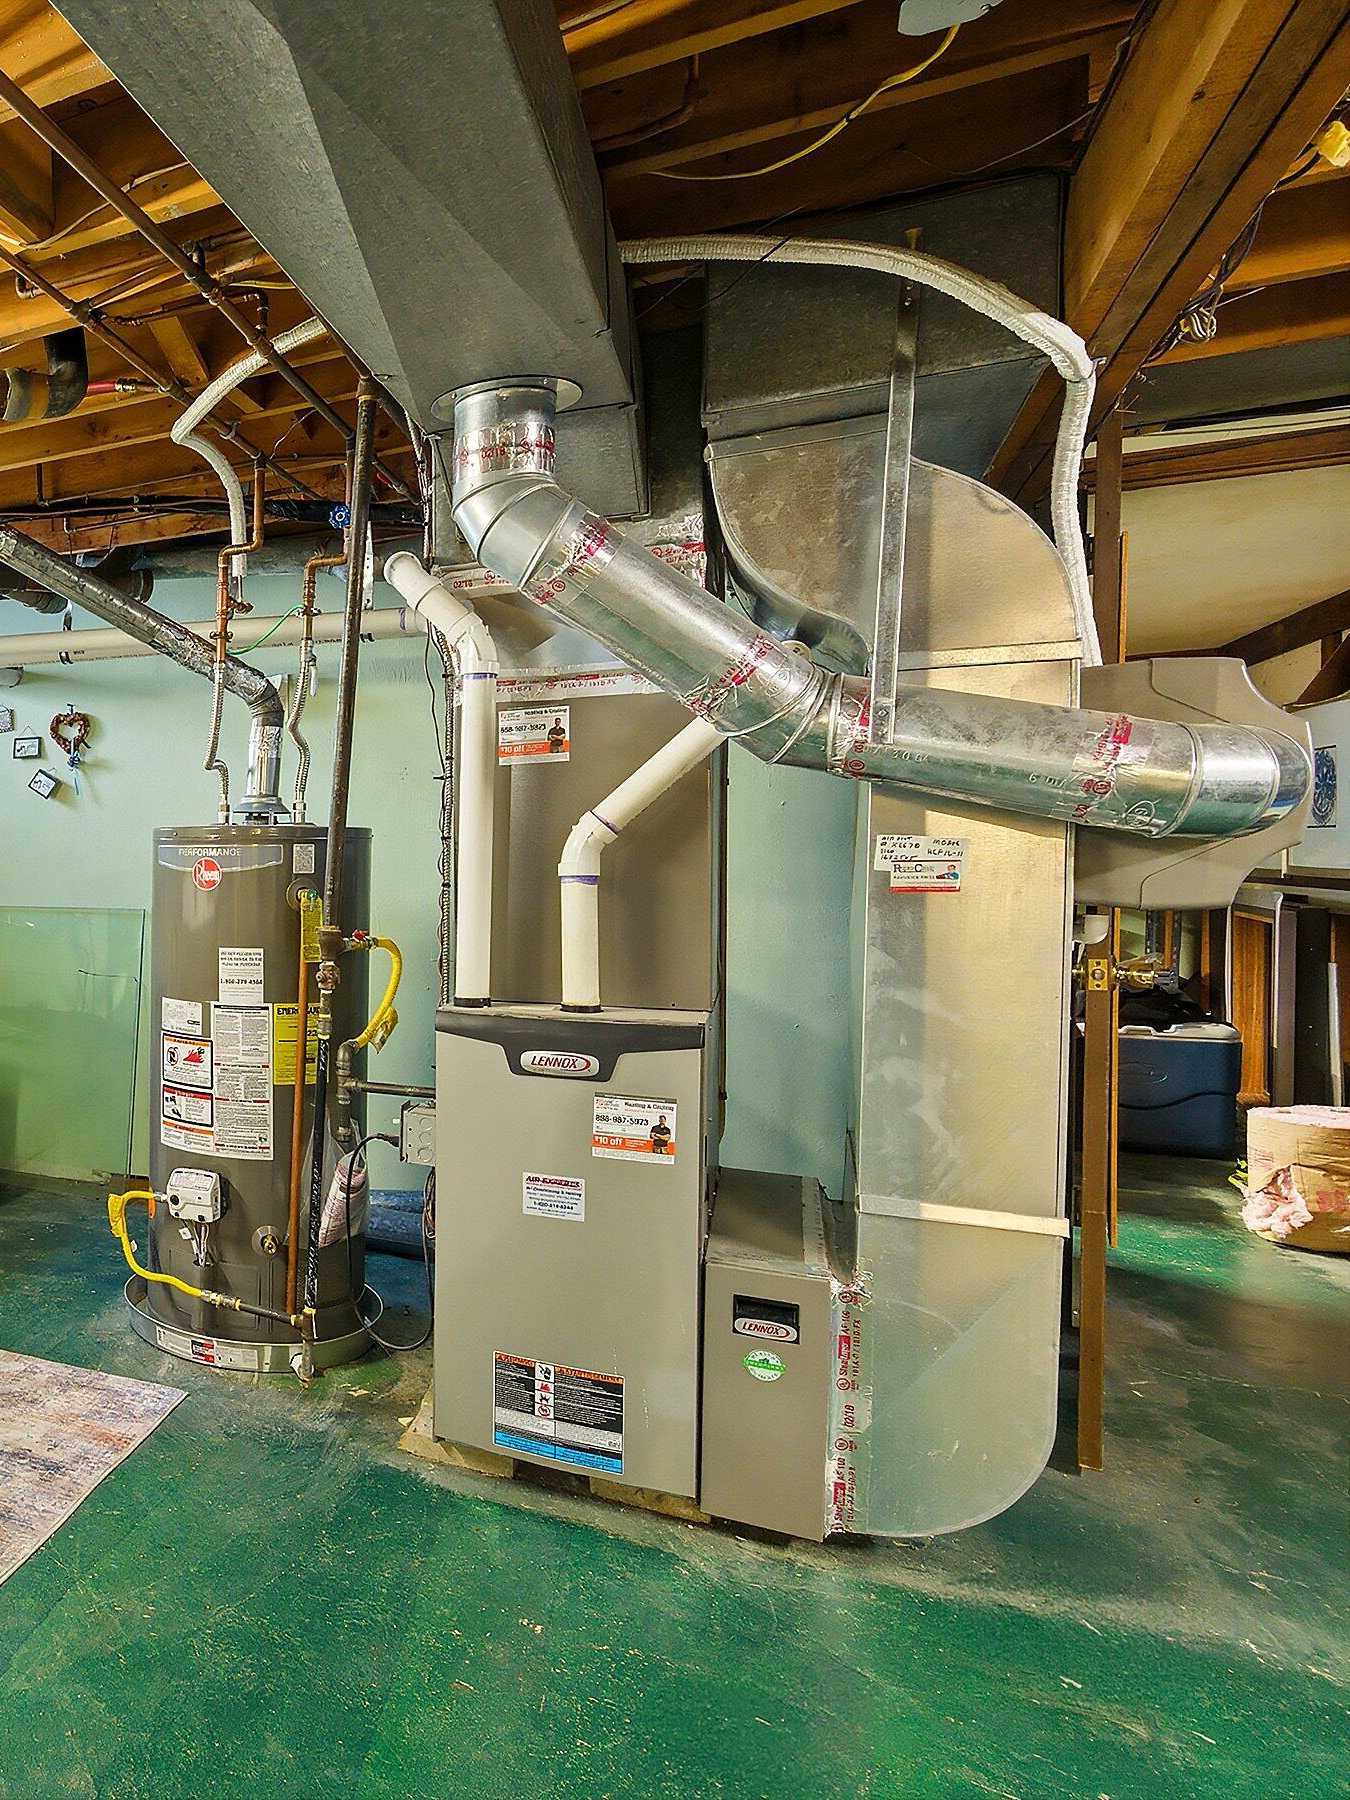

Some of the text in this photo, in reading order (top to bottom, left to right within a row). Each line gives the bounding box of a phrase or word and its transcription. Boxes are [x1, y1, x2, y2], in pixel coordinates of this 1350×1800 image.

[178, 847, 242, 857] PERFORMANCE
[530, 1055, 579, 1069] LENNOX
[610, 1137, 622, 1146] off
[742, 1322, 780, 1336] LENNOX
